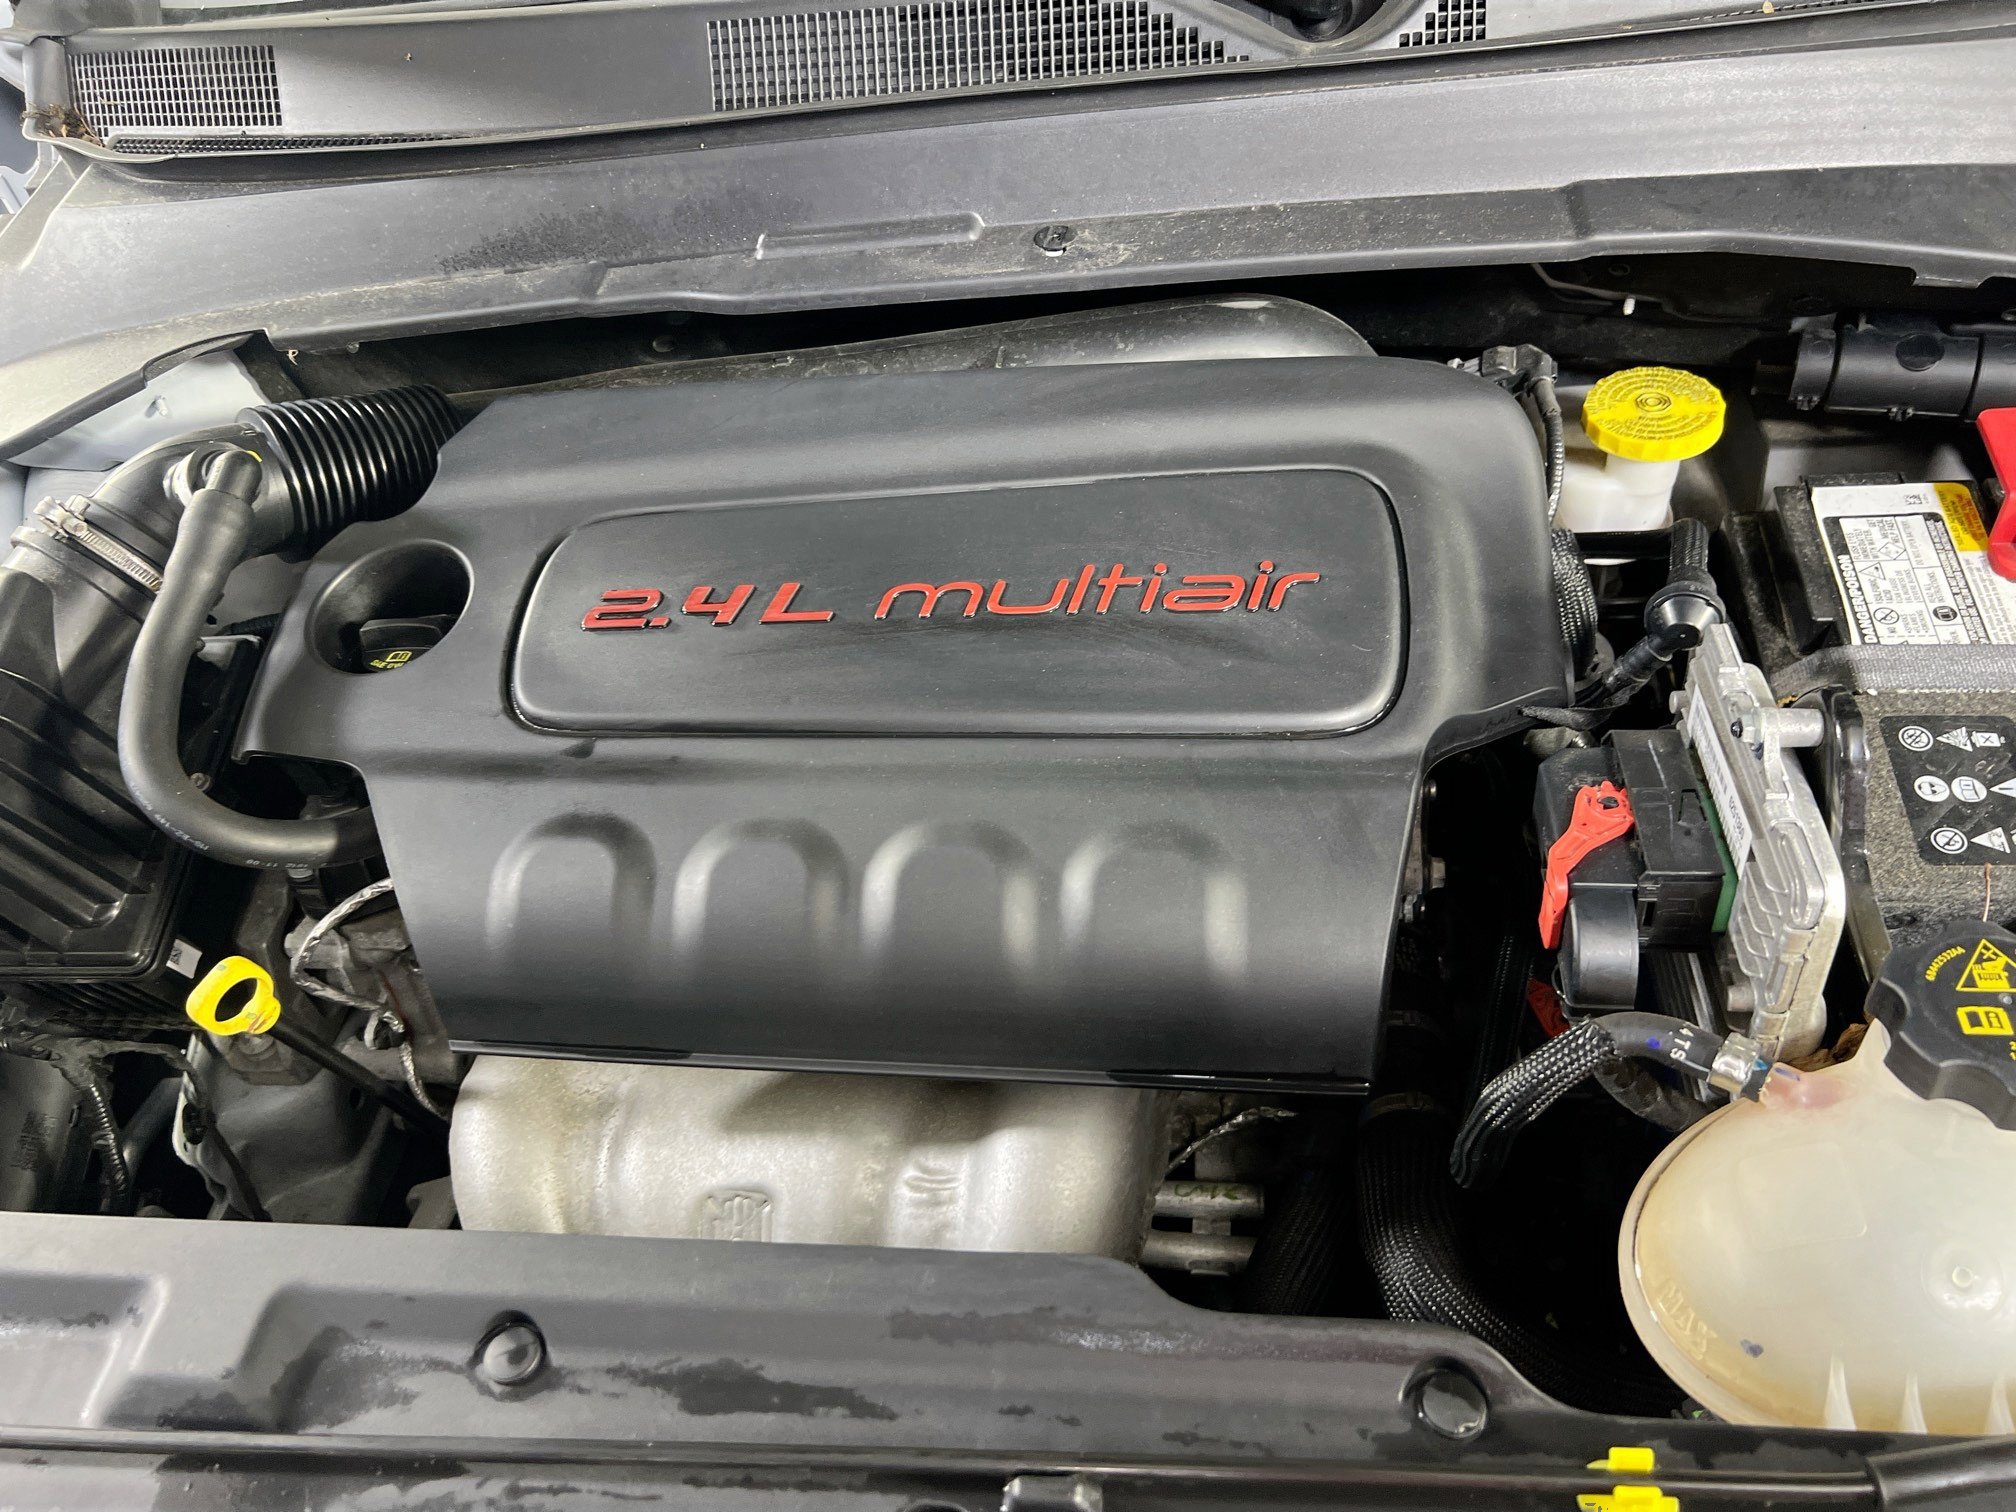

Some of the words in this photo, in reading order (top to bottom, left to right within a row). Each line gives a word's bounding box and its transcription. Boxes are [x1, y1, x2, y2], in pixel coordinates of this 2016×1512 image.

[581, 583, 835, 630] 2.4L
[874, 560, 1320, 621] multiair
[1838, 555, 1877, 643] DANGER/POISON
